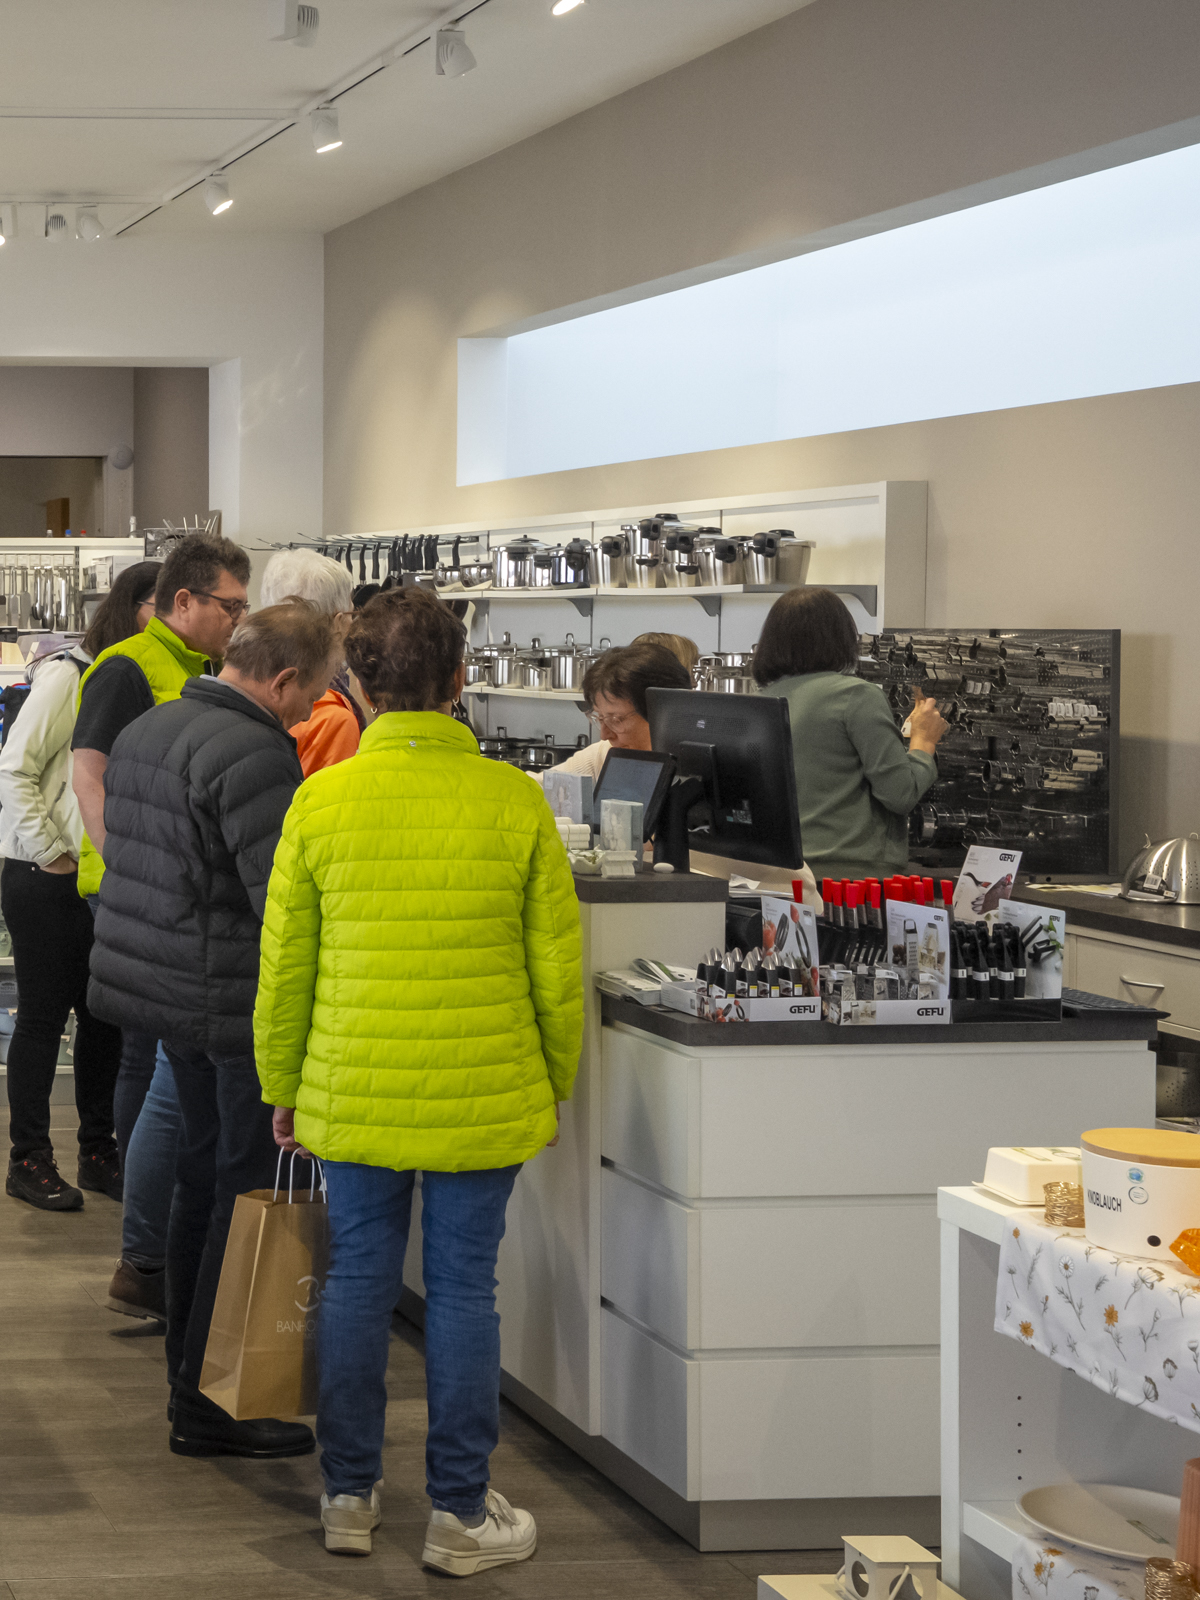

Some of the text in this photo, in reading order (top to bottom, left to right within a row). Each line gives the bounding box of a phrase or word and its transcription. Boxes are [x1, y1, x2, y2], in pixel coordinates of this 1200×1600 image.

[999, 853, 1015, 863] GEFU
[789, 1005, 816, 1014] GEFU
[917, 1008, 944, 1017] GEFU
[1087, 1188, 1122, 1213] KNOBLAUCH
[276, 1320, 317, 1333] BANHO
